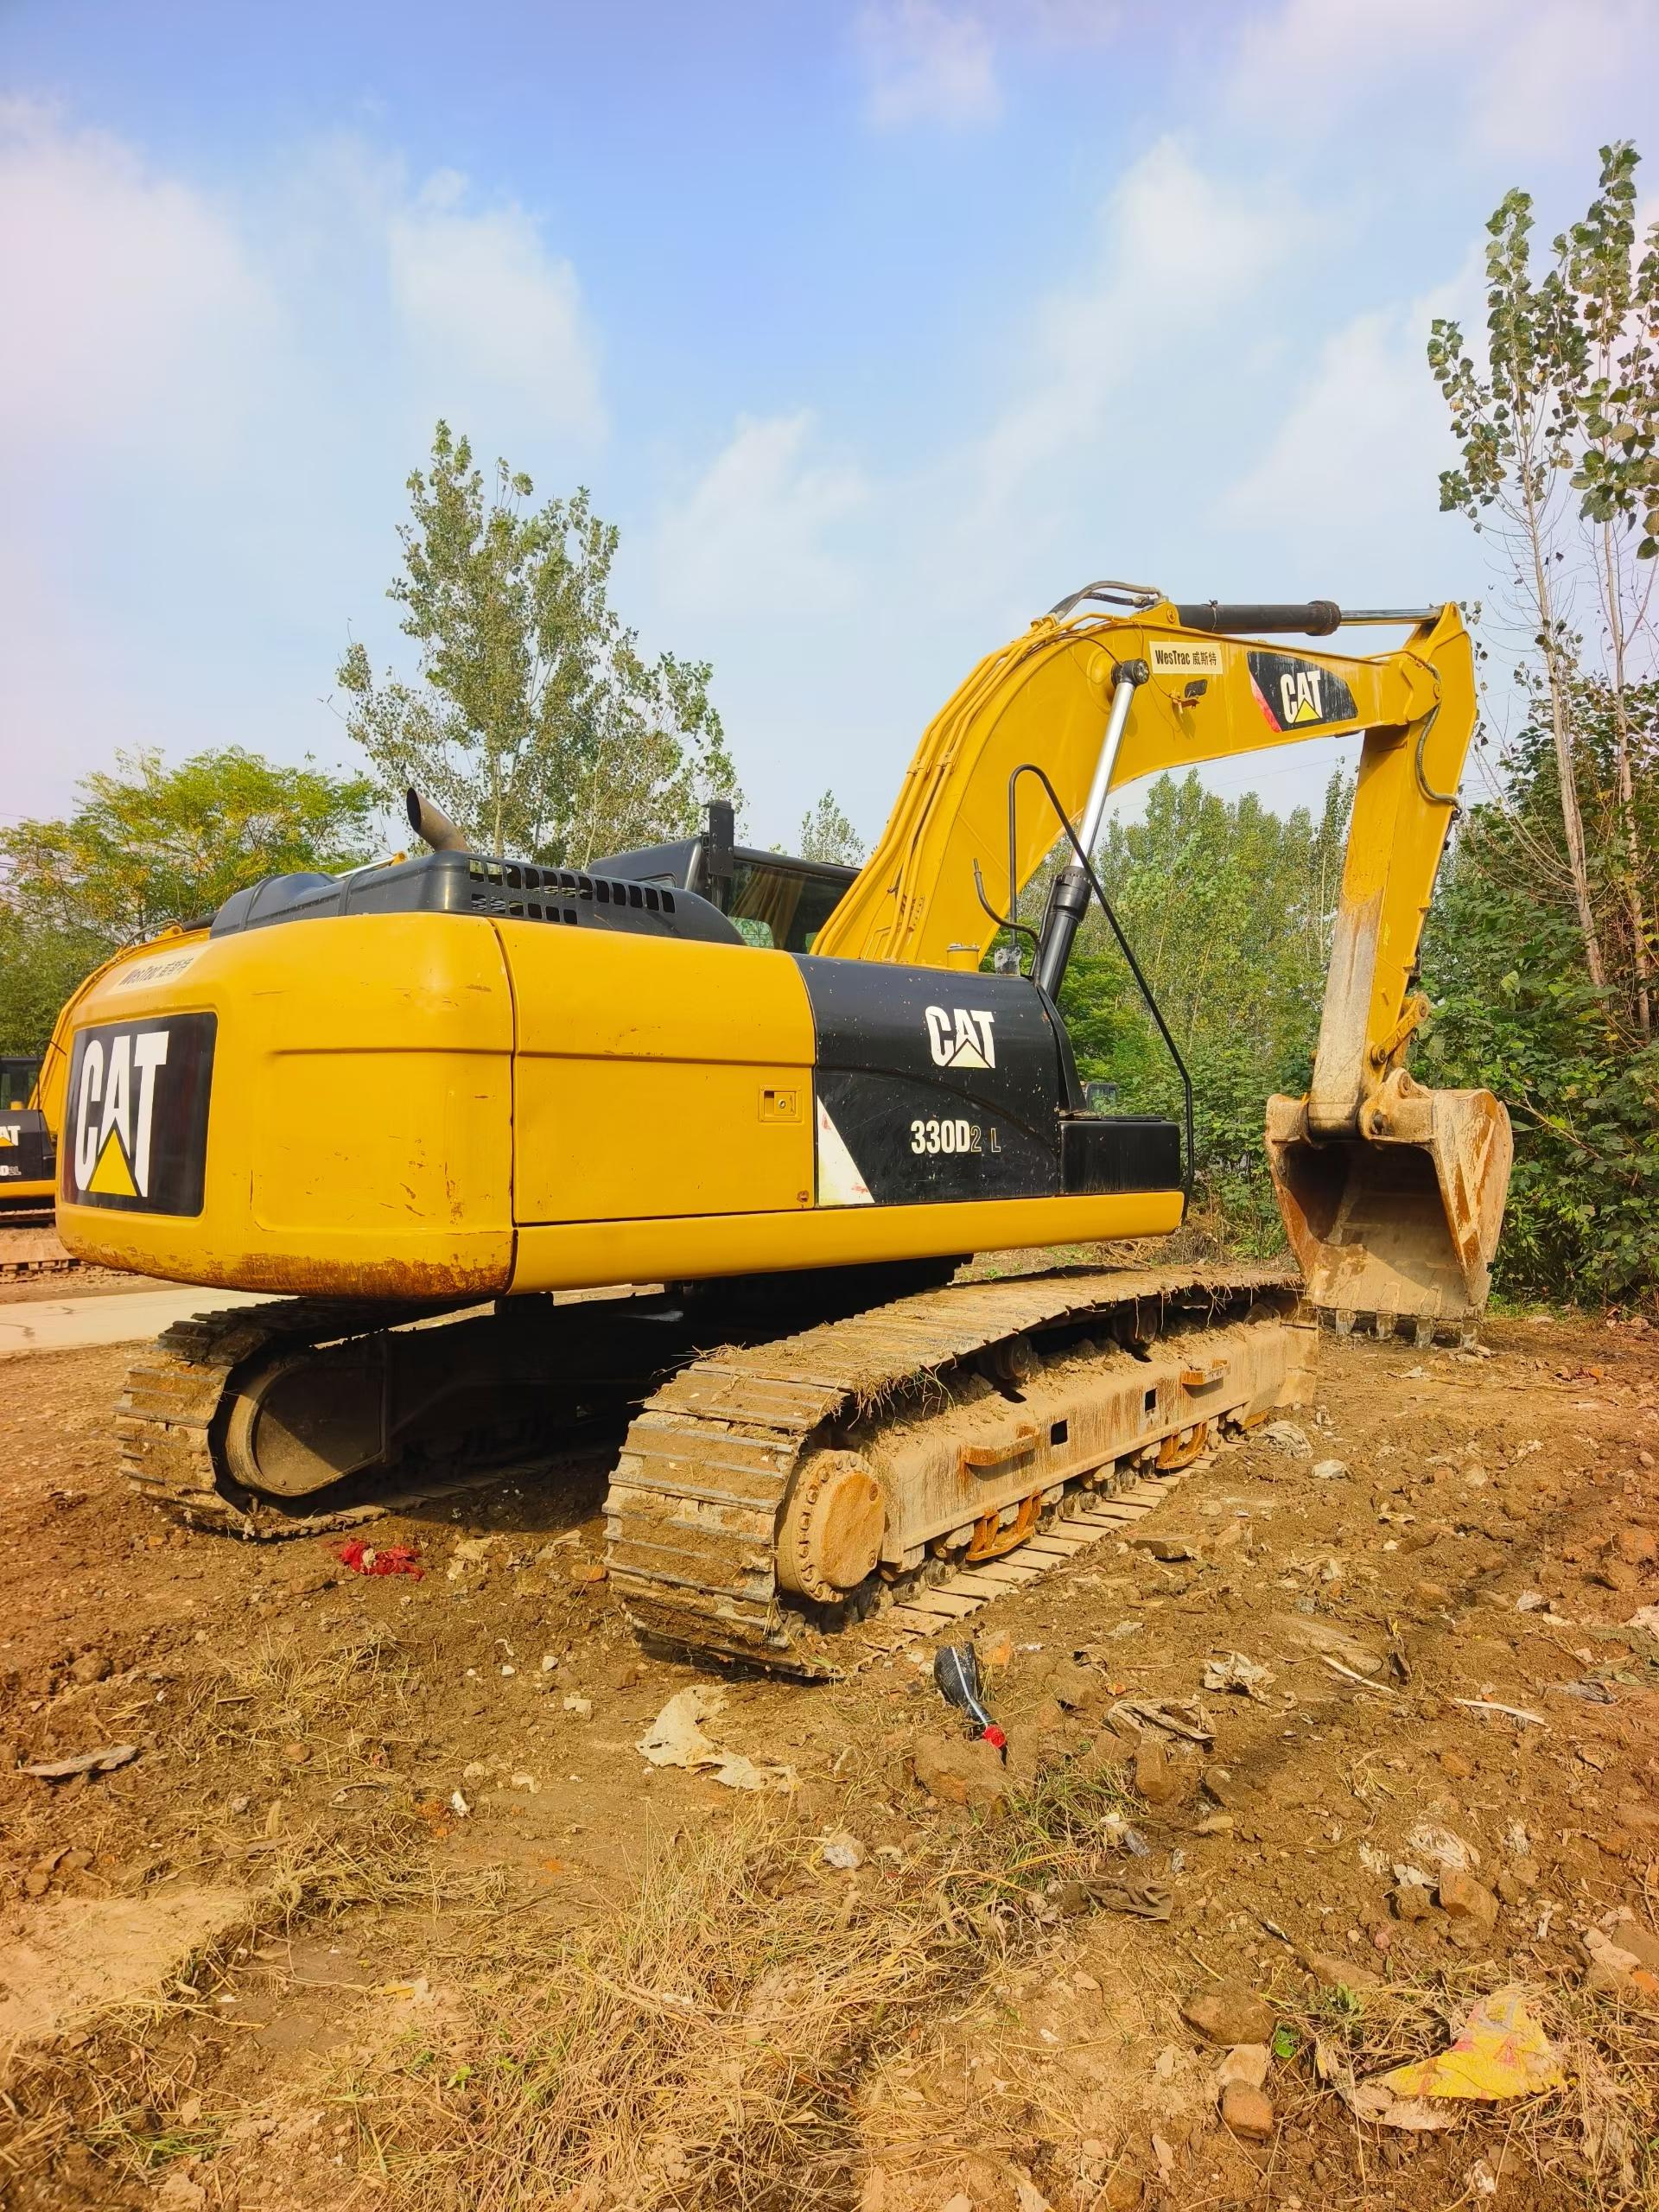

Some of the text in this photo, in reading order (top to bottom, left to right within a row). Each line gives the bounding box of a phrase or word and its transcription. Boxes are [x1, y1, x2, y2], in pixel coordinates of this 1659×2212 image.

[1155, 650, 1217, 665] WesTrac 威斯特
[1281, 671, 1323, 723] CAT
[925, 1006, 995, 1068] CAT
[0, 1125, 21, 1147] AT
[74, 1031, 169, 1198] CAT
